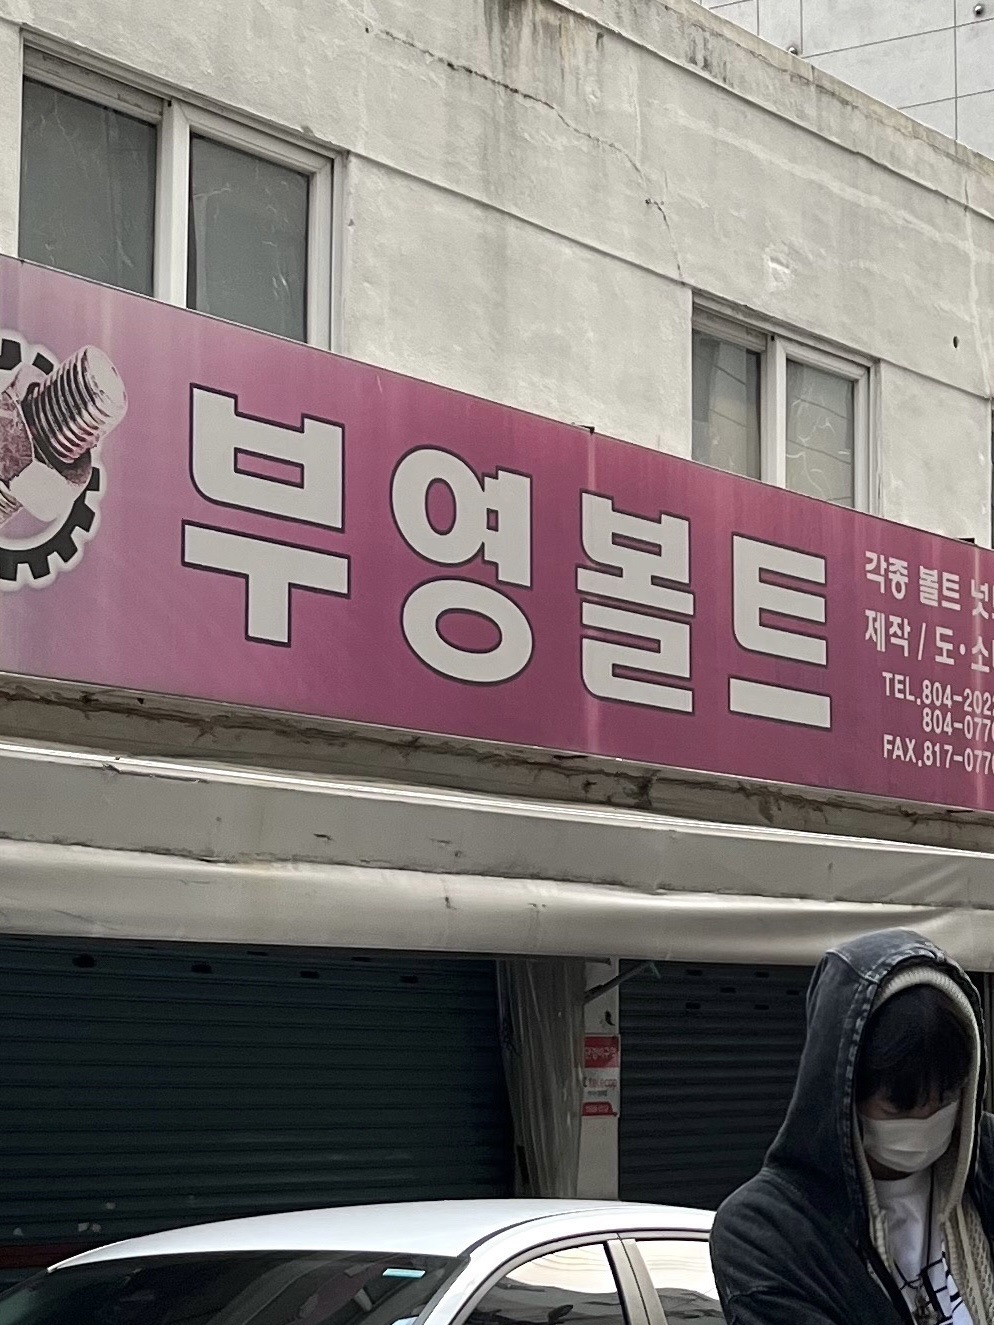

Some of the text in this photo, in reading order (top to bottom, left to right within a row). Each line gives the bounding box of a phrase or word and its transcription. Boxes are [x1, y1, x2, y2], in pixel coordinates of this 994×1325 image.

[181, 382, 833, 731] 부영볼트
[865, 550, 909, 600] 각종
[918, 565, 961, 611] 볼트
[864, 609, 911, 657] 제작
